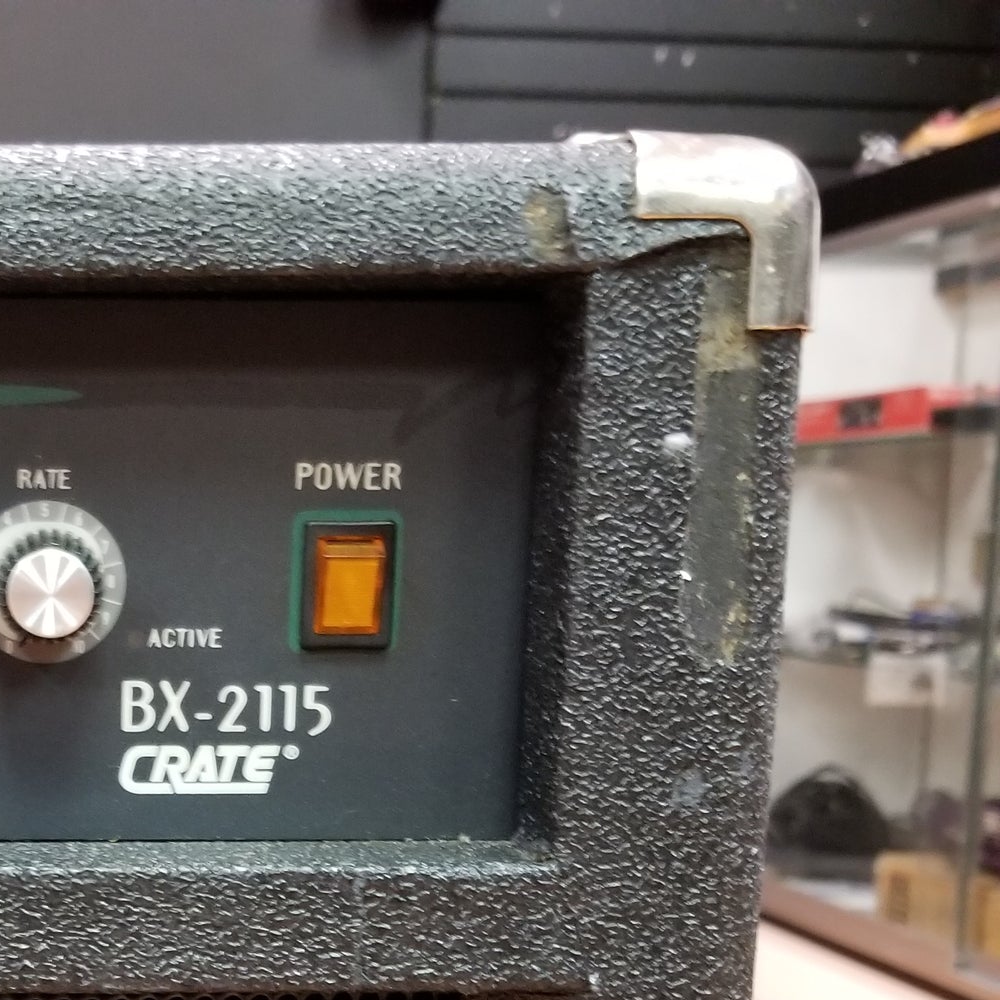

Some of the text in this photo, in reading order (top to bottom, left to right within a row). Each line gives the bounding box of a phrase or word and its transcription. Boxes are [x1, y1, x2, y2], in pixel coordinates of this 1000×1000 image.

[16, 468, 72, 490] RATE
[294, 462, 402, 490] POWER
[147, 628, 223, 648] ACTIVE
[119, 680, 333, 737] BX-2115
[118, 745, 281, 794] CRATE
